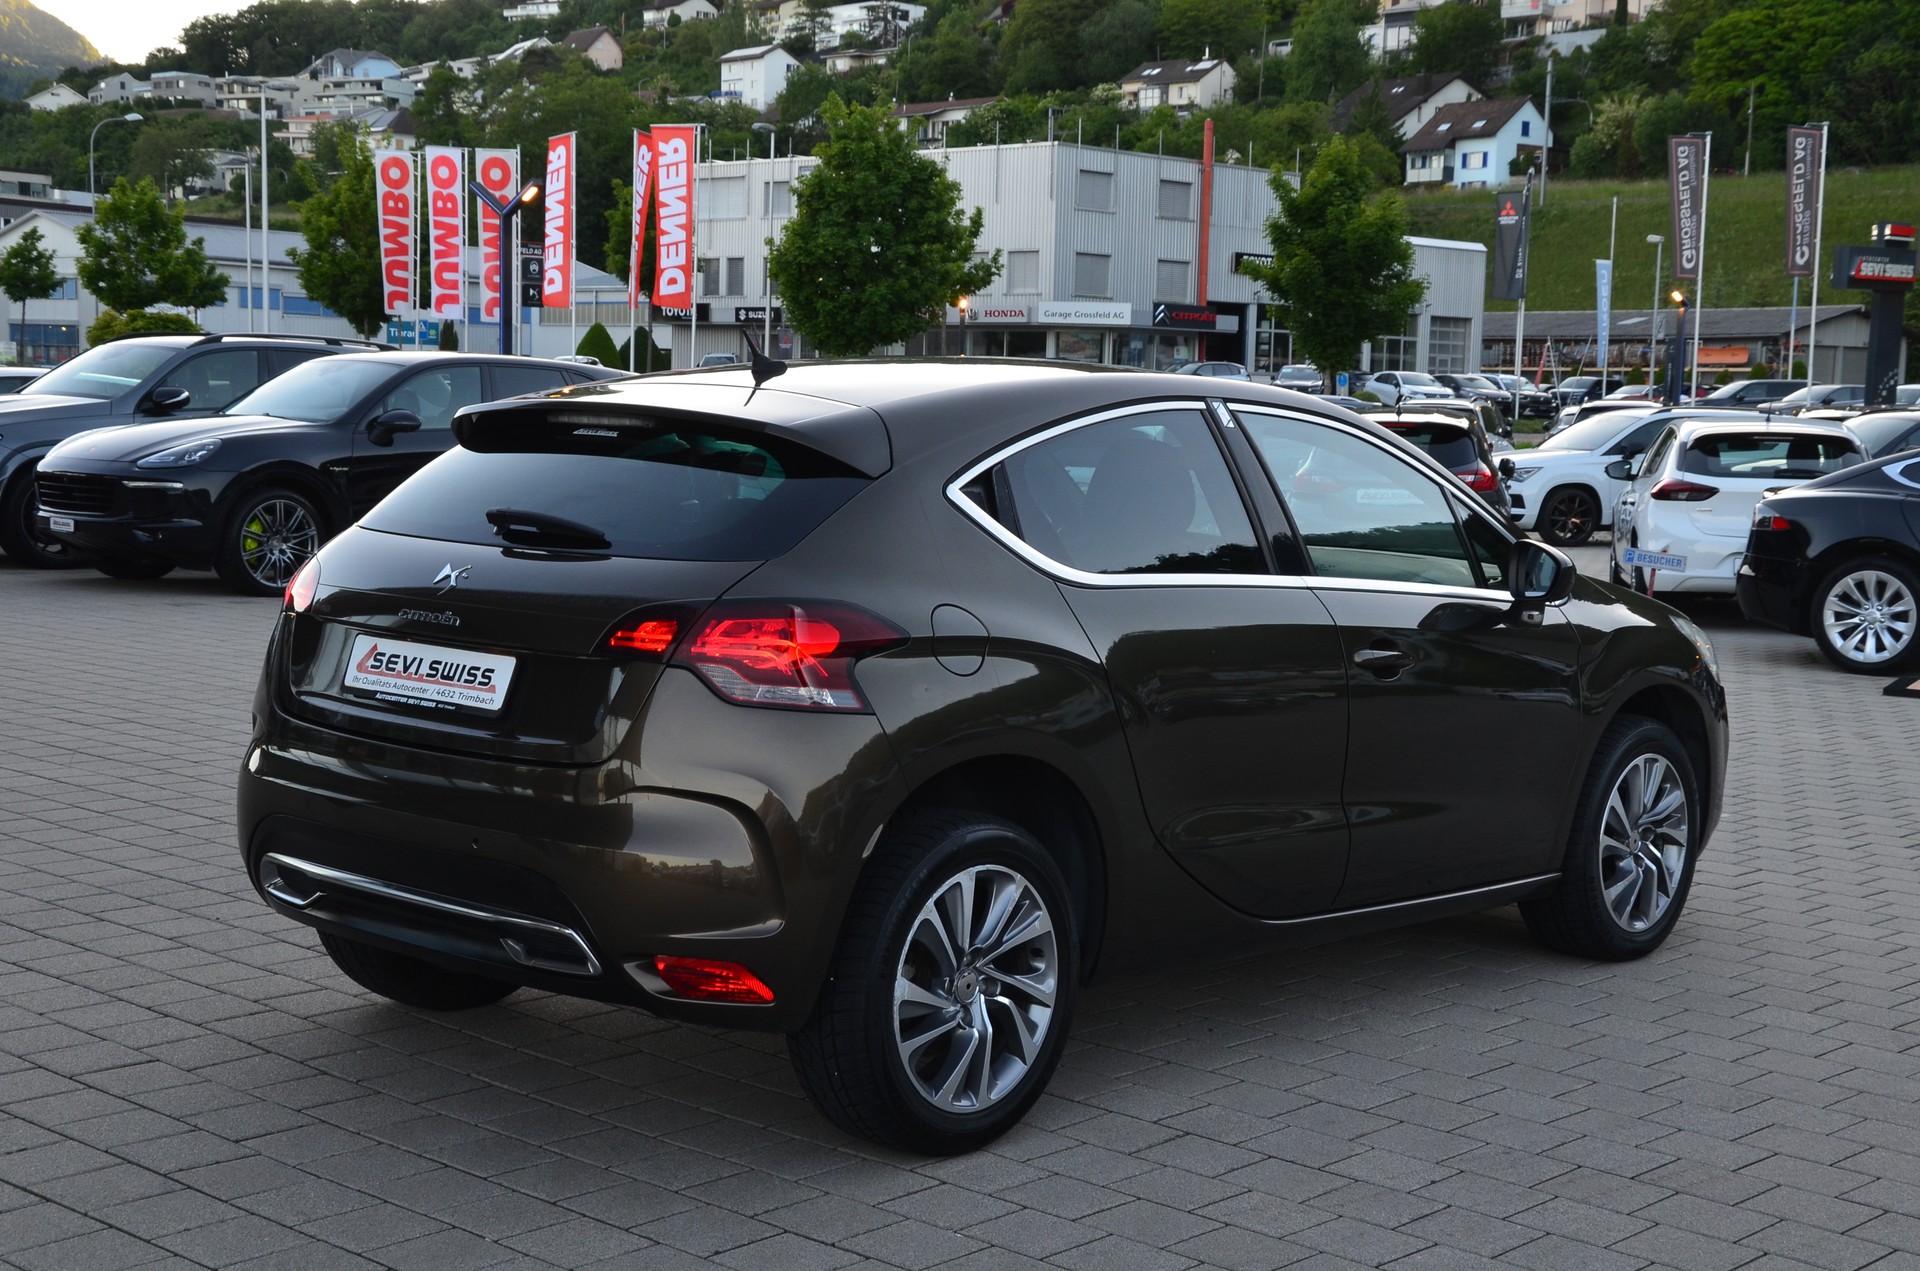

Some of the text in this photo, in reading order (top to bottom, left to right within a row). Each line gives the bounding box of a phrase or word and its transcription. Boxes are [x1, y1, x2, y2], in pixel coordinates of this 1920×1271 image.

[748, 311, 774, 319] SUZUI
[984, 309, 1025, 318] HONDA
[1044, 309, 1125, 319] Garage Grossfeld AG
[1637, 553, 1682, 567] BESUCHER
[370, 652, 496, 687] SEVI SWISS
[352, 674, 362, 684] Ihr
[391, 680, 430, 695] Autocenter
[436, 689, 455, 699] 4632
[458, 692, 495, 706] Trimbach
